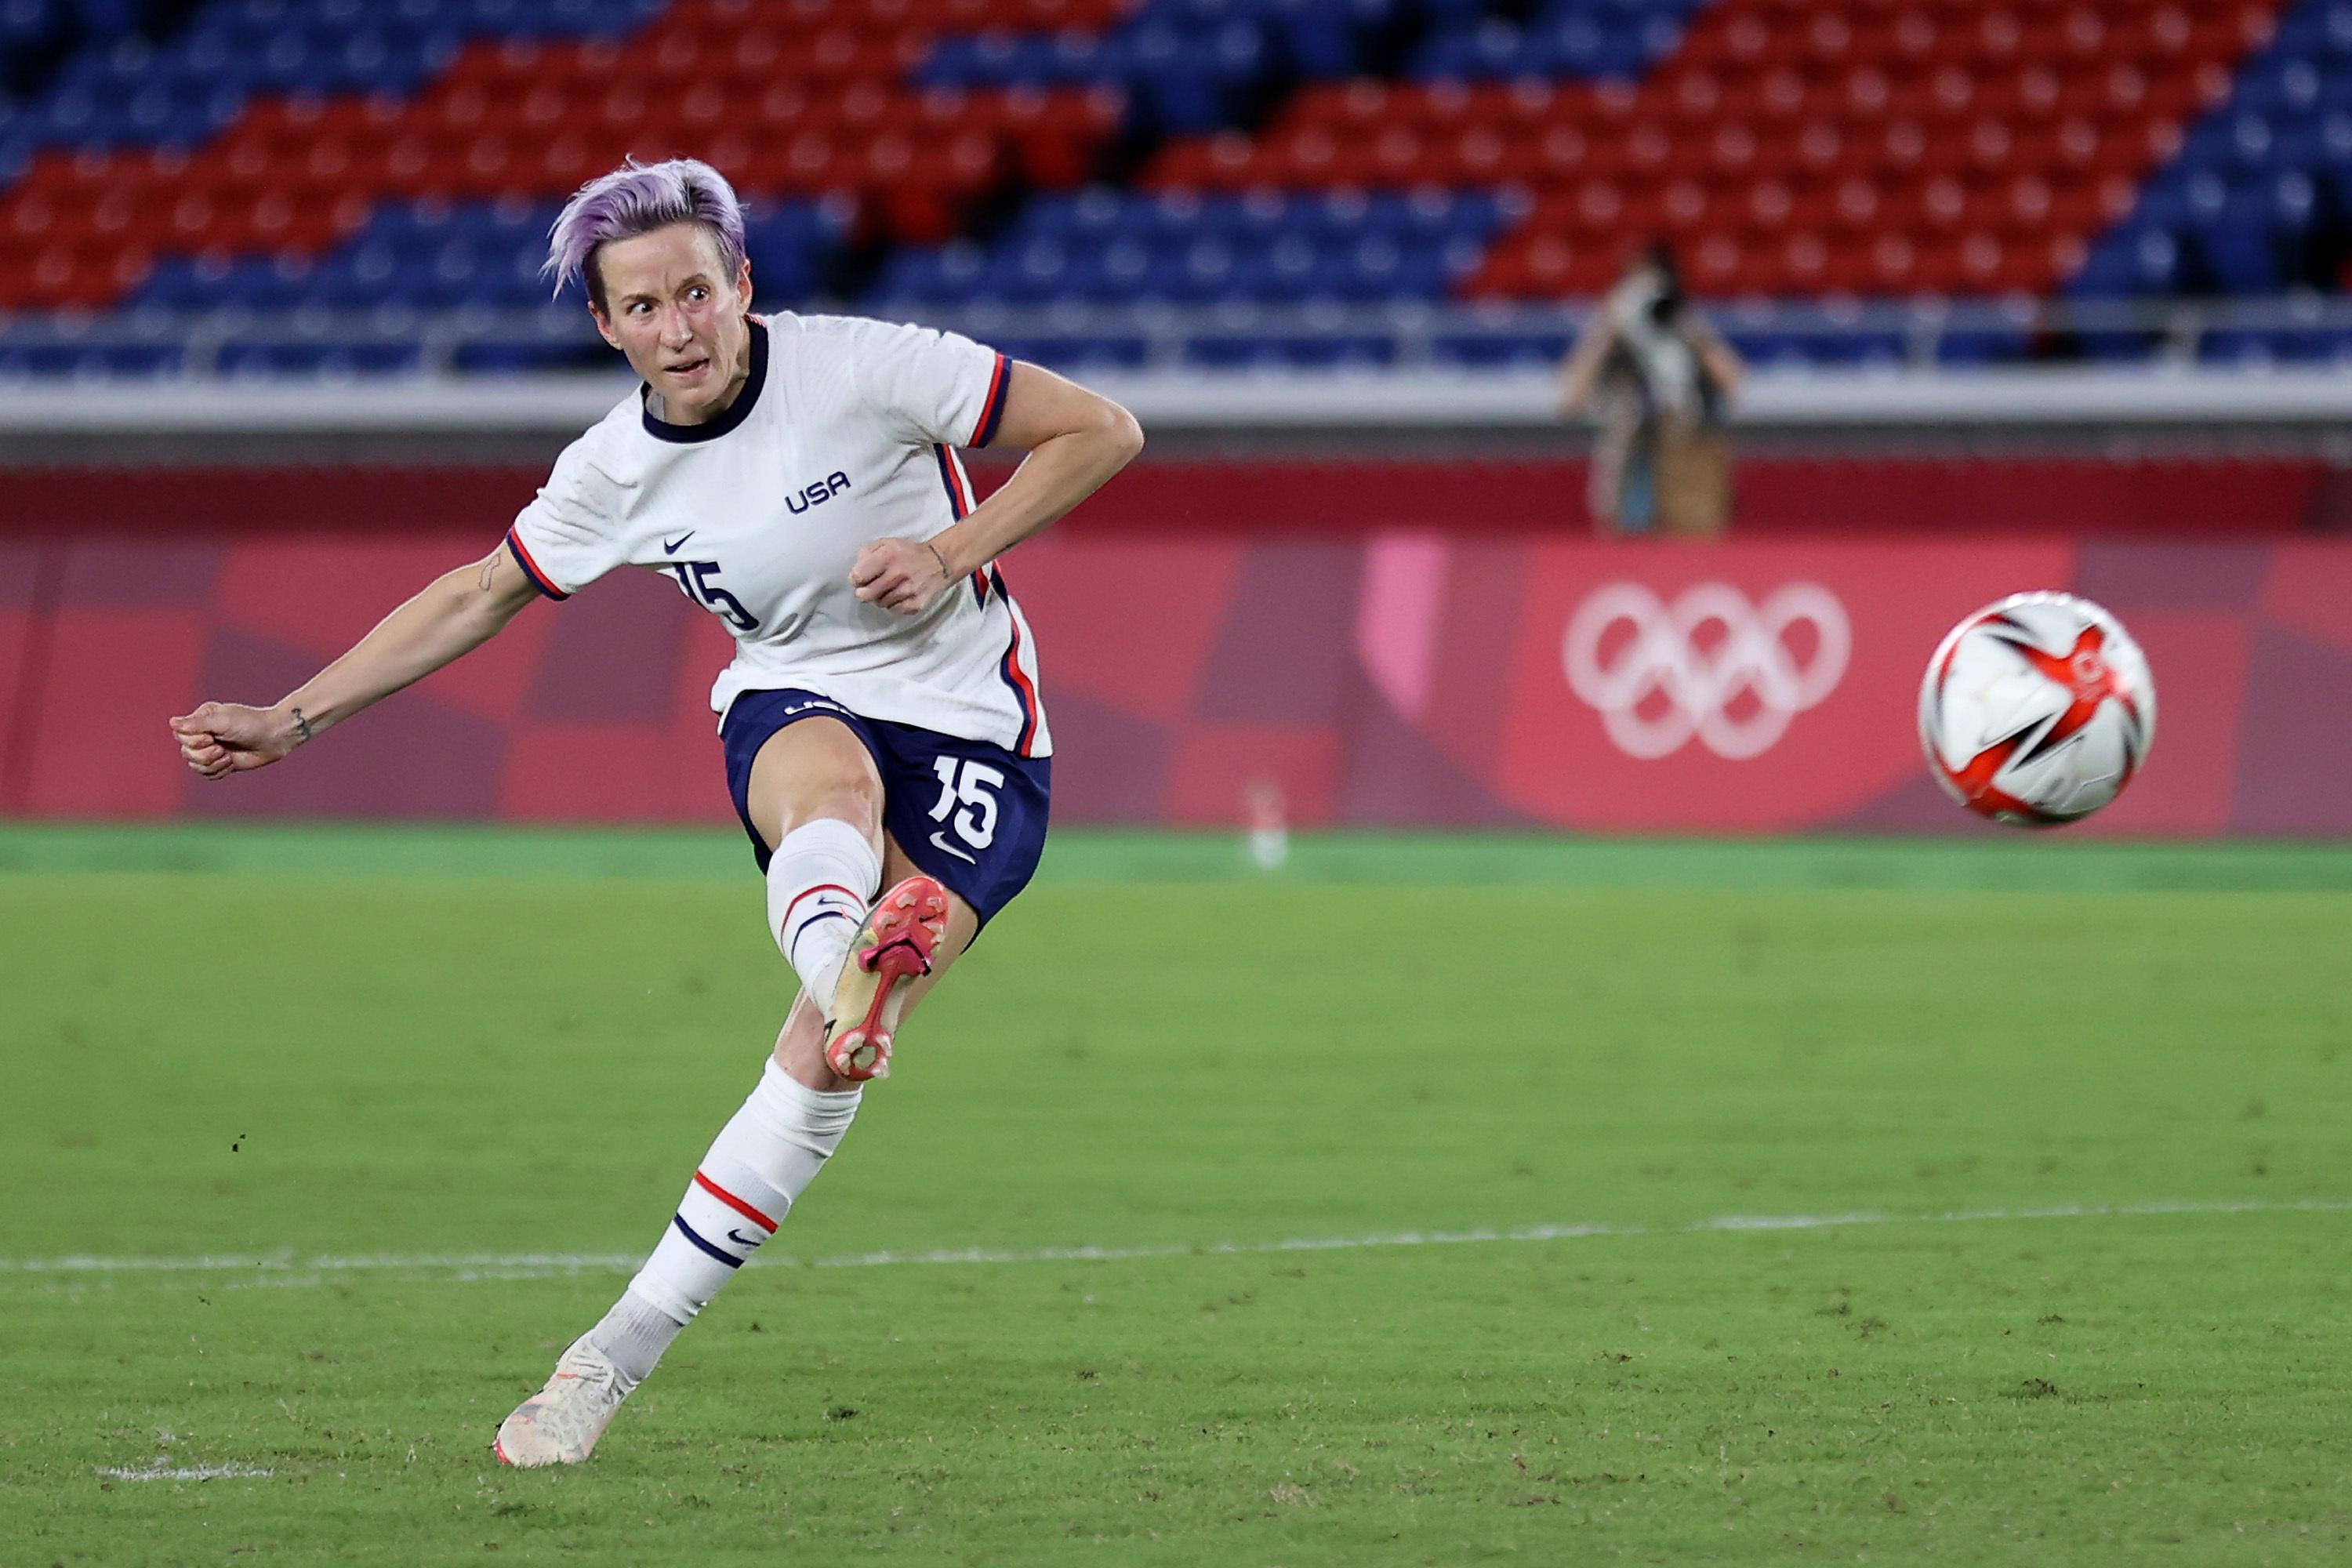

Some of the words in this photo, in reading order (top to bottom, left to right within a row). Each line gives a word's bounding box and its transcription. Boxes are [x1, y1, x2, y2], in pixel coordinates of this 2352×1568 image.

[785, 471, 851, 514] USA
[672, 561, 760, 631] 15
[928, 755, 1004, 849] 15
